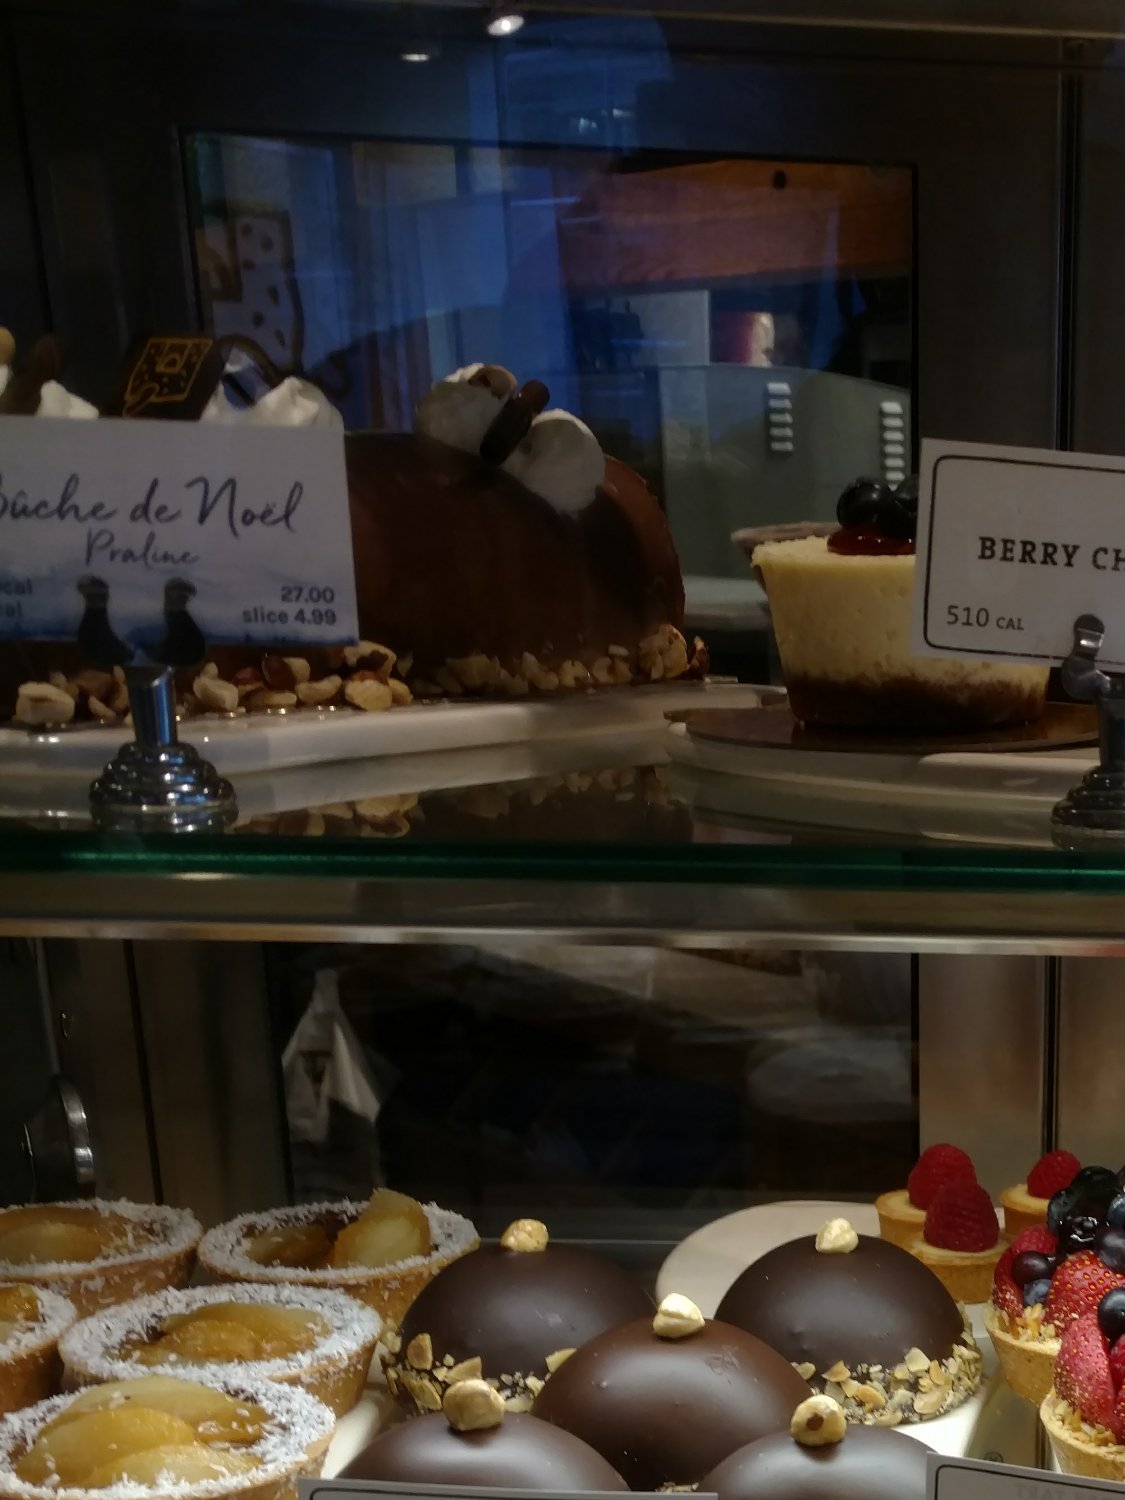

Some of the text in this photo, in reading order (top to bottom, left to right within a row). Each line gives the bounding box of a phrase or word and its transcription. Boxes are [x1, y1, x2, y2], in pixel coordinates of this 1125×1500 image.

[0, 473, 304, 539] ûche de Noël
[84, 528, 200, 570] Praline
[977, 536, 1081, 568] BERRY
[280, 585, 336, 605] 27.00
[242, 606, 337, 626] slice 4.99
[946, 605, 1024, 631] 510 CAL
